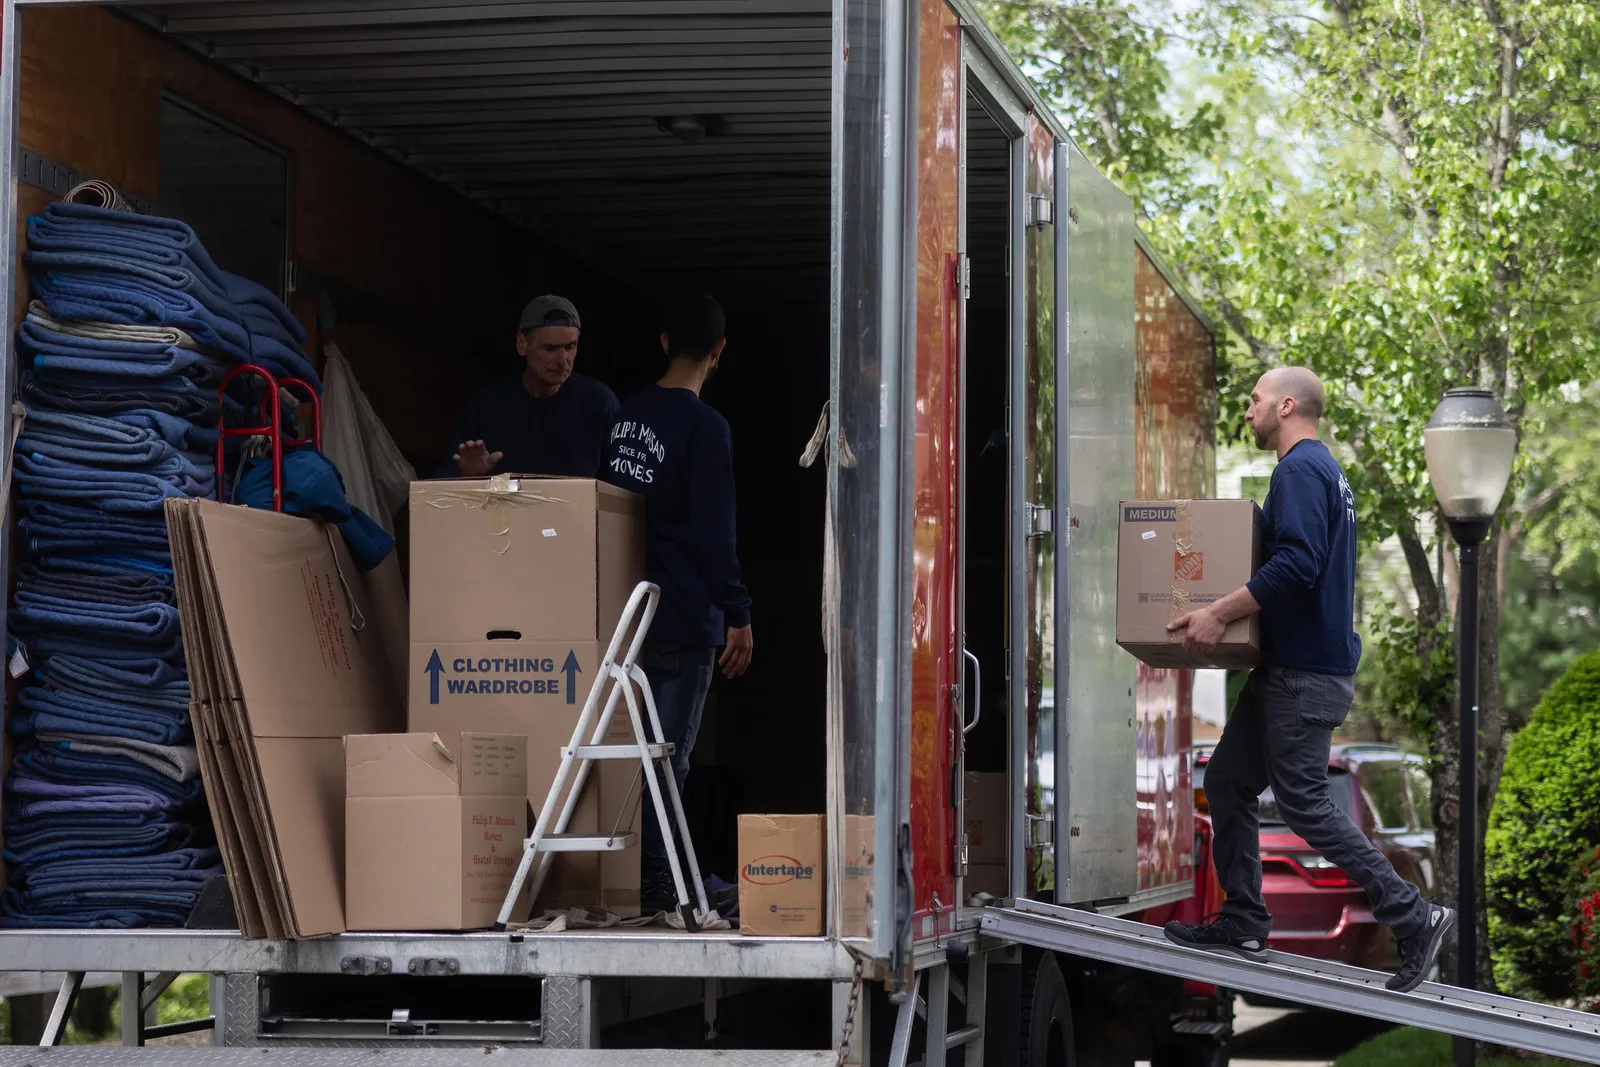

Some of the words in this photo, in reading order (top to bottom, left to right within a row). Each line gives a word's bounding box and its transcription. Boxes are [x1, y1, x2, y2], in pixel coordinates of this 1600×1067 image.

[610, 457, 654, 483] MOVES
[452, 658, 554, 673] CLOTHING
[447, 679, 559, 694] WARDROBE
[747, 863, 813, 879] Intertape
